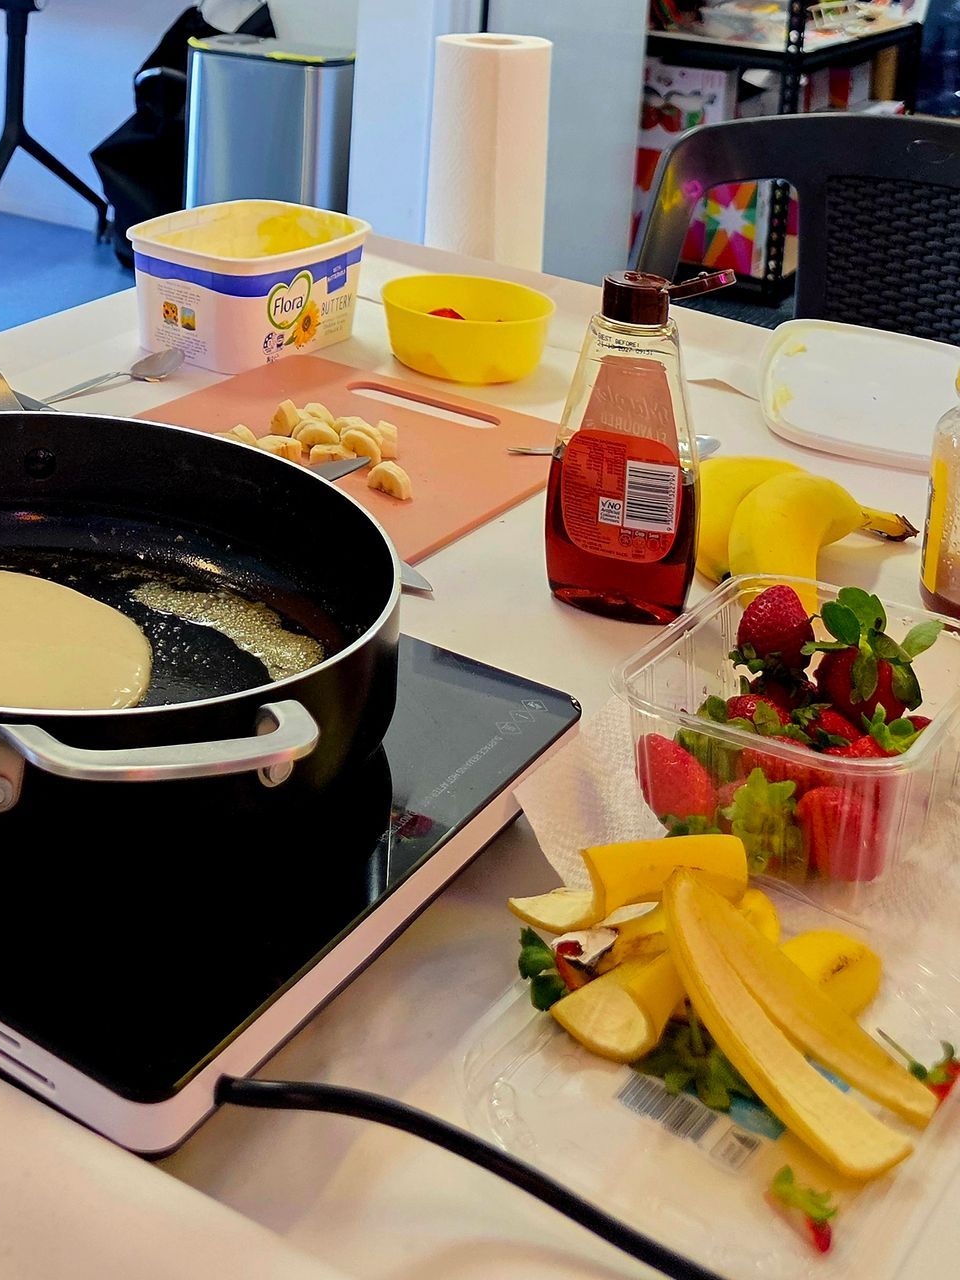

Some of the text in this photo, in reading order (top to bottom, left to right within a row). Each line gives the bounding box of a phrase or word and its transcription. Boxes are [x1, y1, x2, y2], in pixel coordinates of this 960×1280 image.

[273, 296, 304, 317] Flora
[320, 293, 353, 317] BUTTERY
[607, 502, 622, 511] NO
